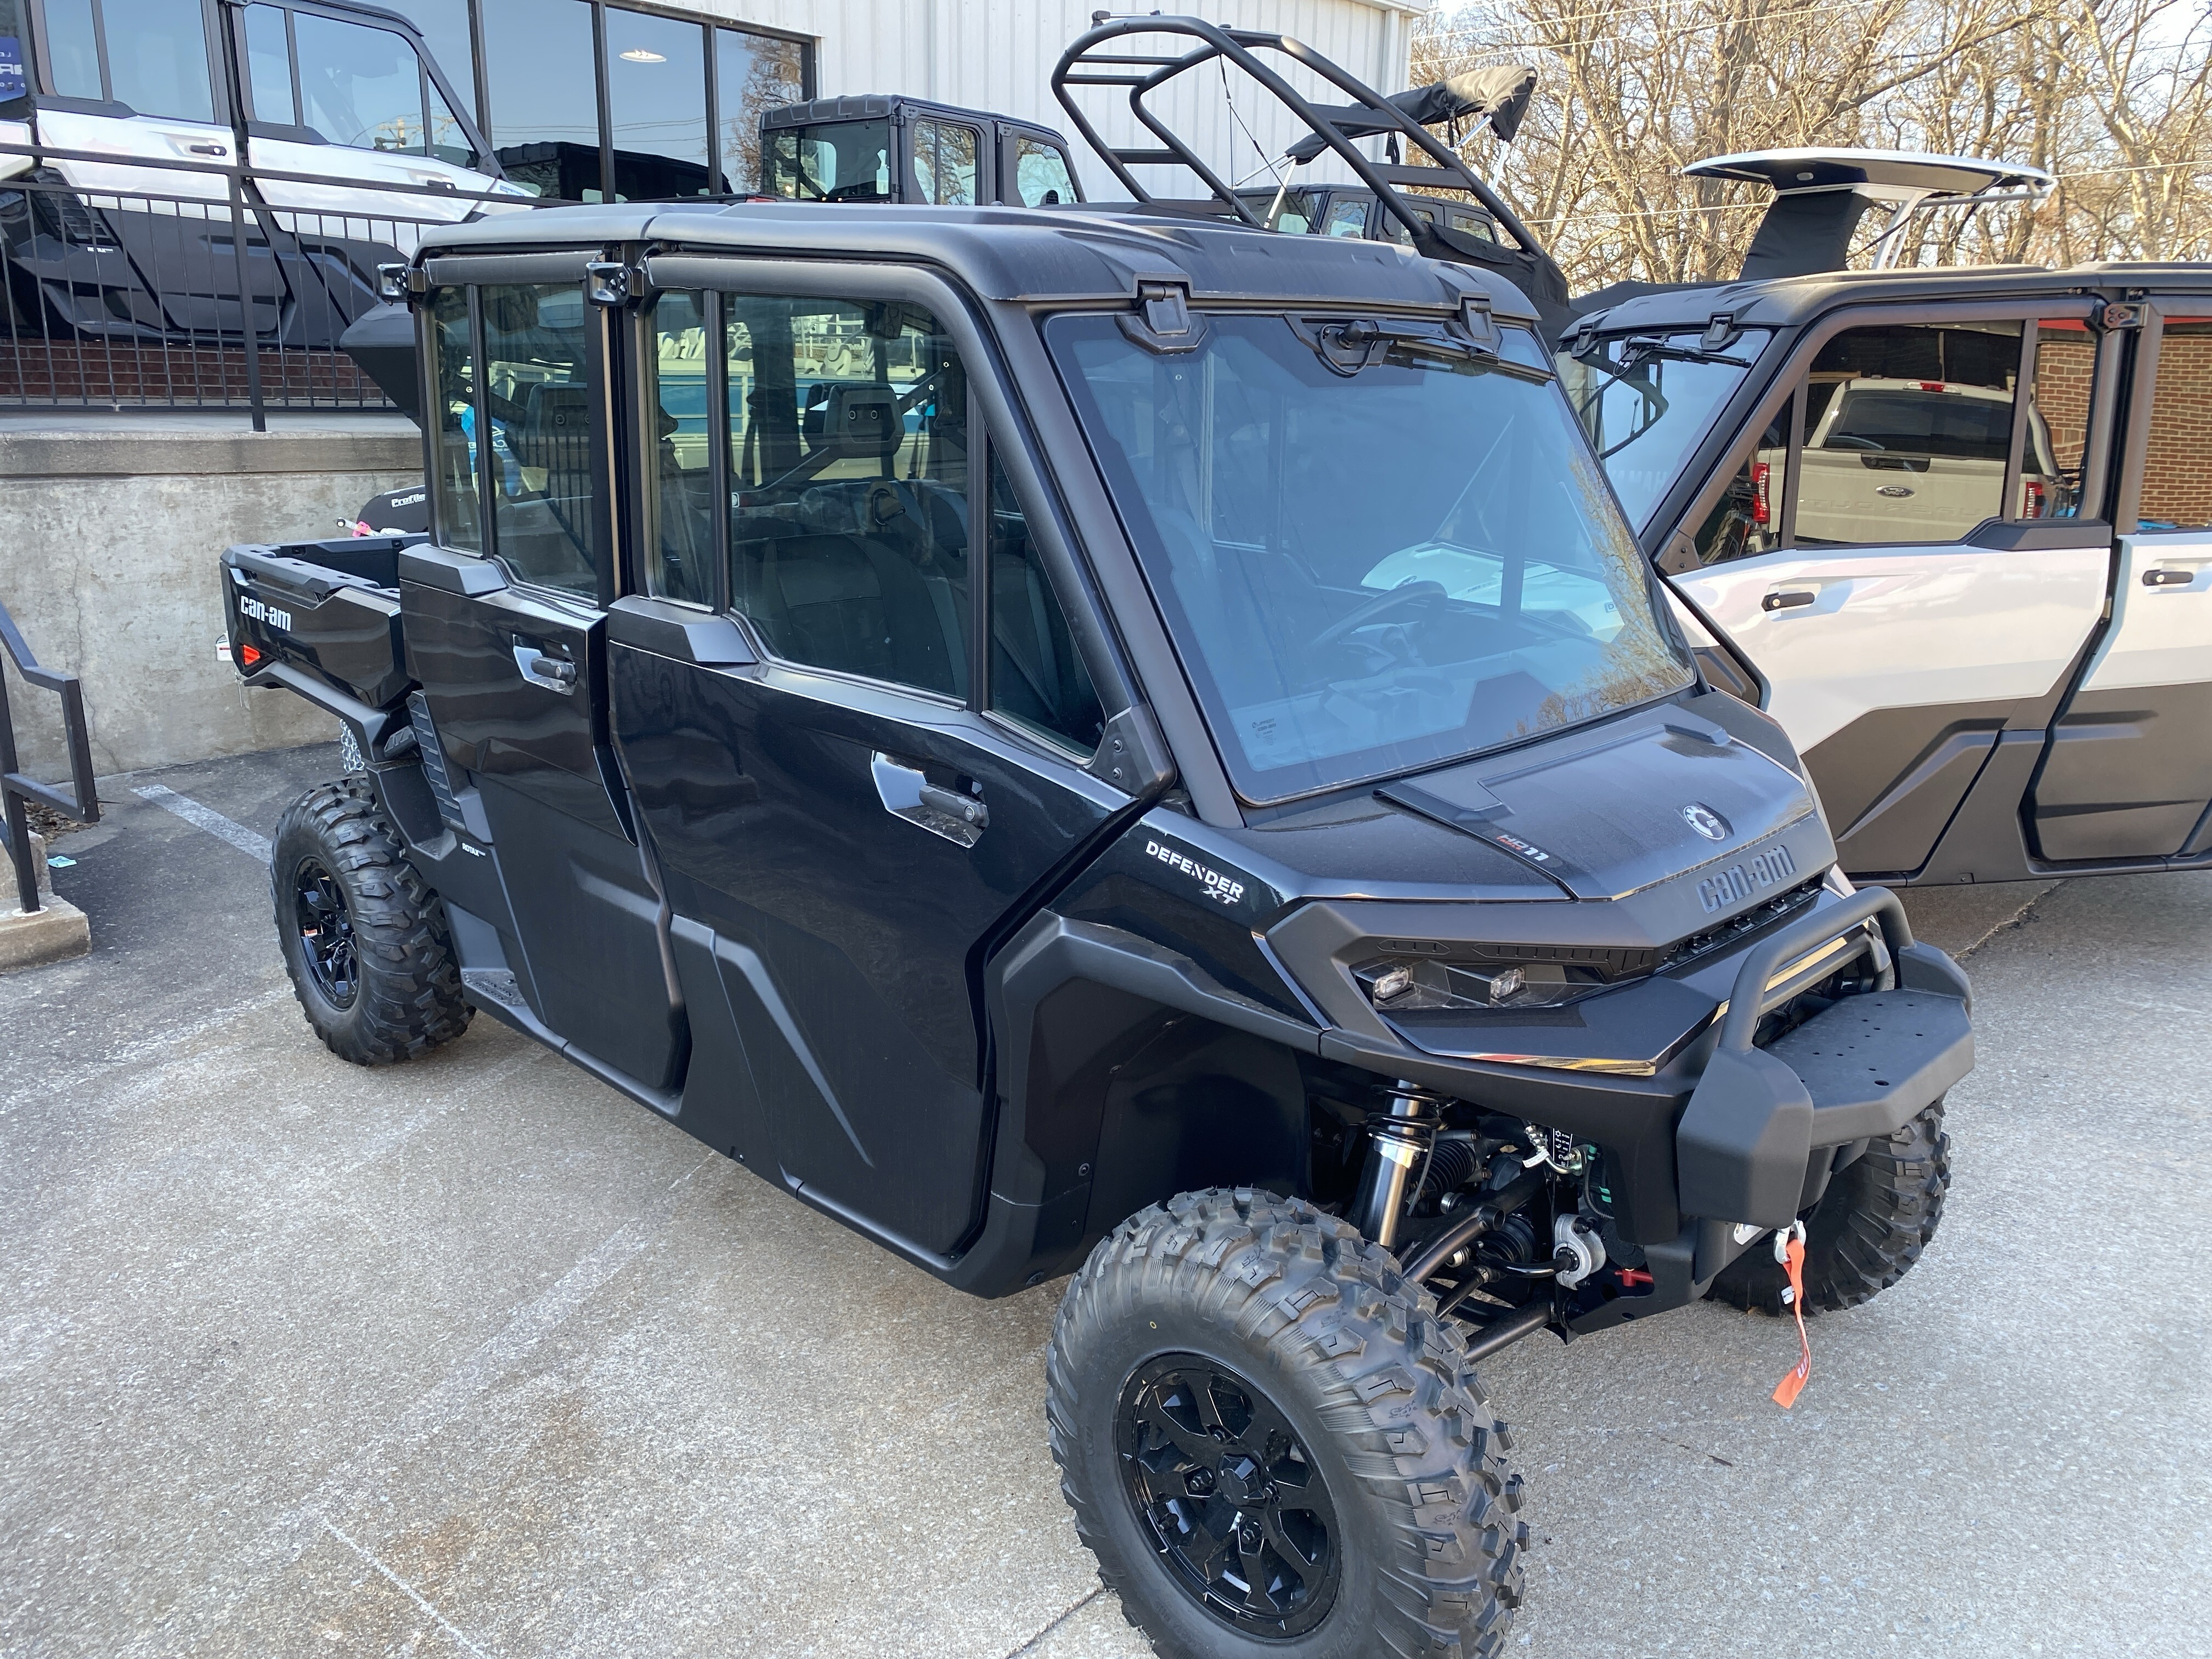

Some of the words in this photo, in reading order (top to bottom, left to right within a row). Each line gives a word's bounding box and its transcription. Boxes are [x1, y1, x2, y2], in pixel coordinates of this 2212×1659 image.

[240, 595, 291, 631] can-am
[1706, 819, 1718, 828] BRP
[462, 842, 479, 857] ROTAX
[1145, 840, 1244, 899] DEFENDER
[1695, 844, 1797, 914] can-am
[1201, 885, 1239, 905] XT
